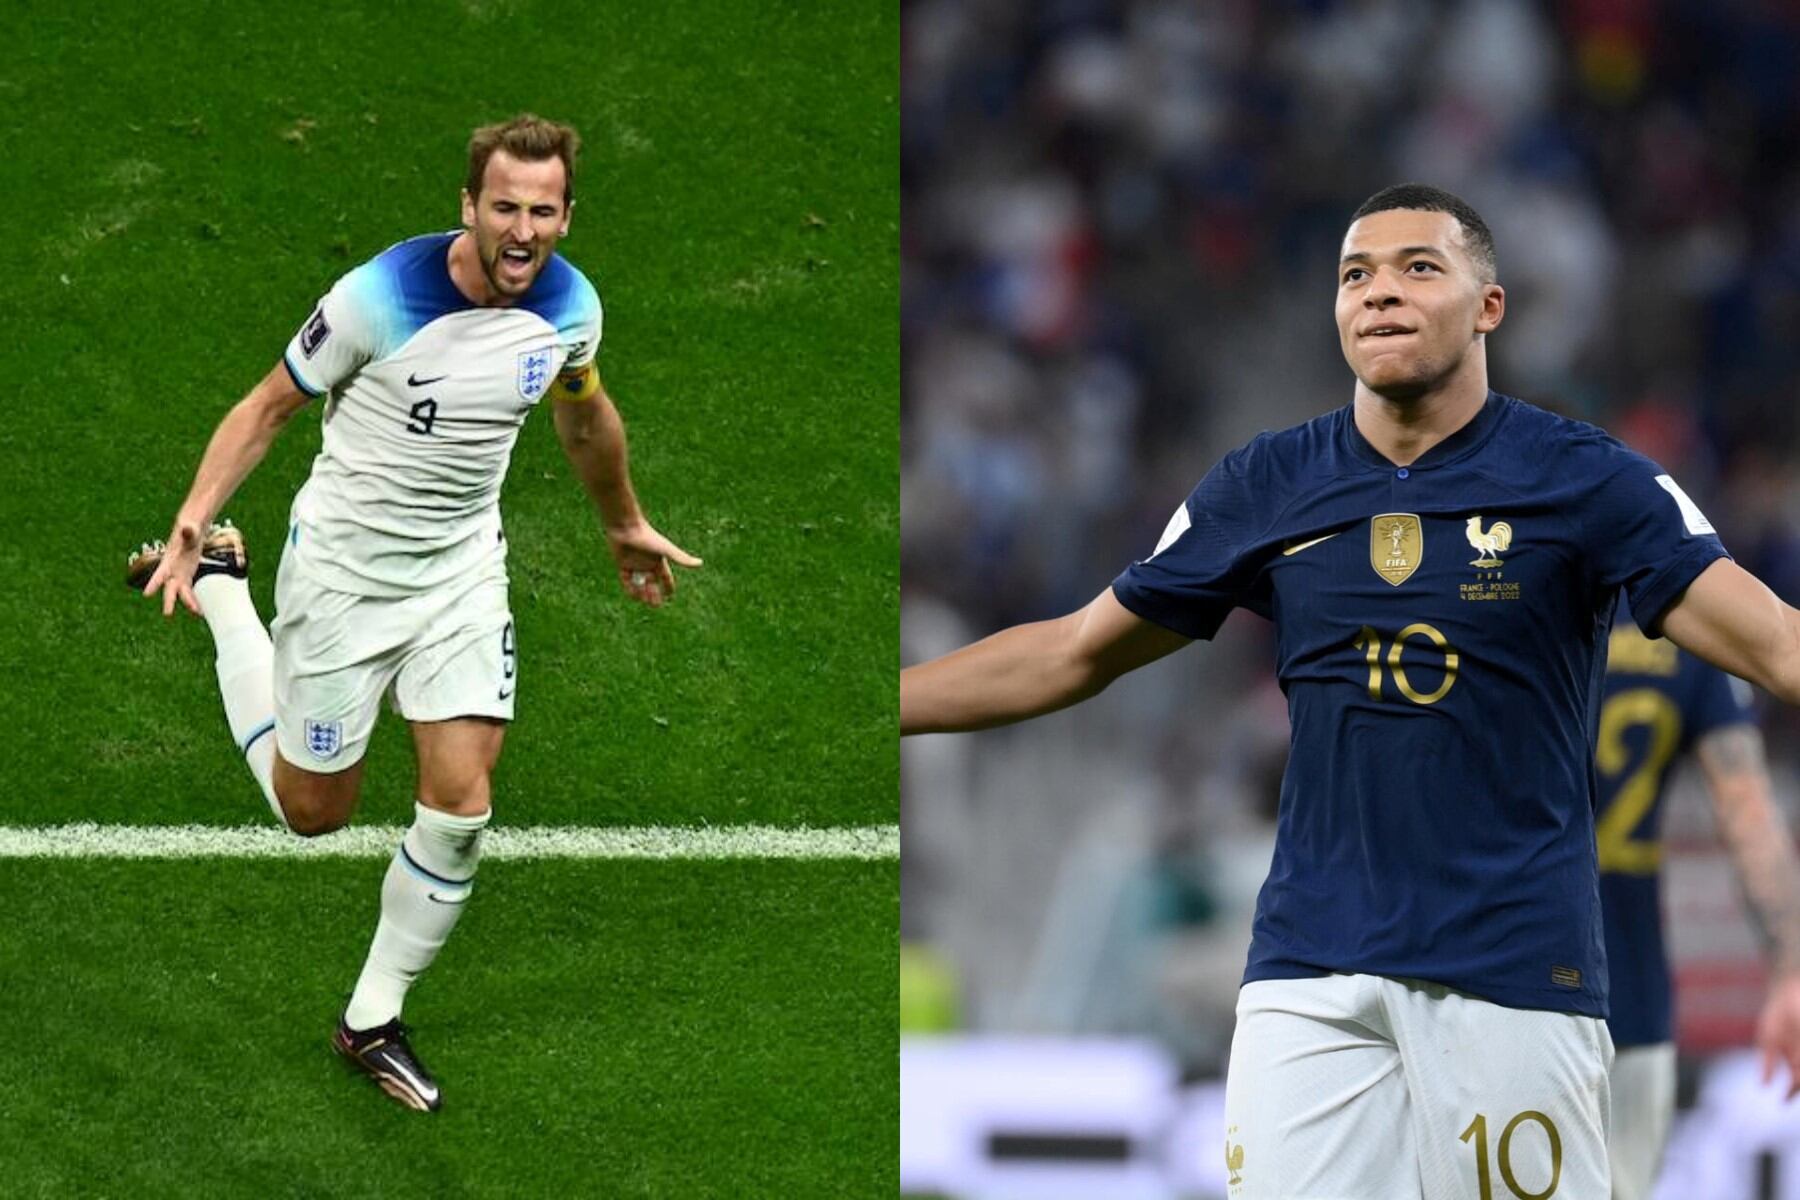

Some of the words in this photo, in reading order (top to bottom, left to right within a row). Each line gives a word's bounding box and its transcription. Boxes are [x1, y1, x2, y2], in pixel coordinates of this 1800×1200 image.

[407, 397, 437, 435] 9
[1386, 559, 1407, 567] FIFA
[1460, 583, 1483, 592] FRANCE
[1490, 582, 1520, 592] POLOGNE
[1501, 591, 1520, 600] 2022
[1353, 623, 1459, 705] 10
[1458, 1110, 1562, 1200] 10
